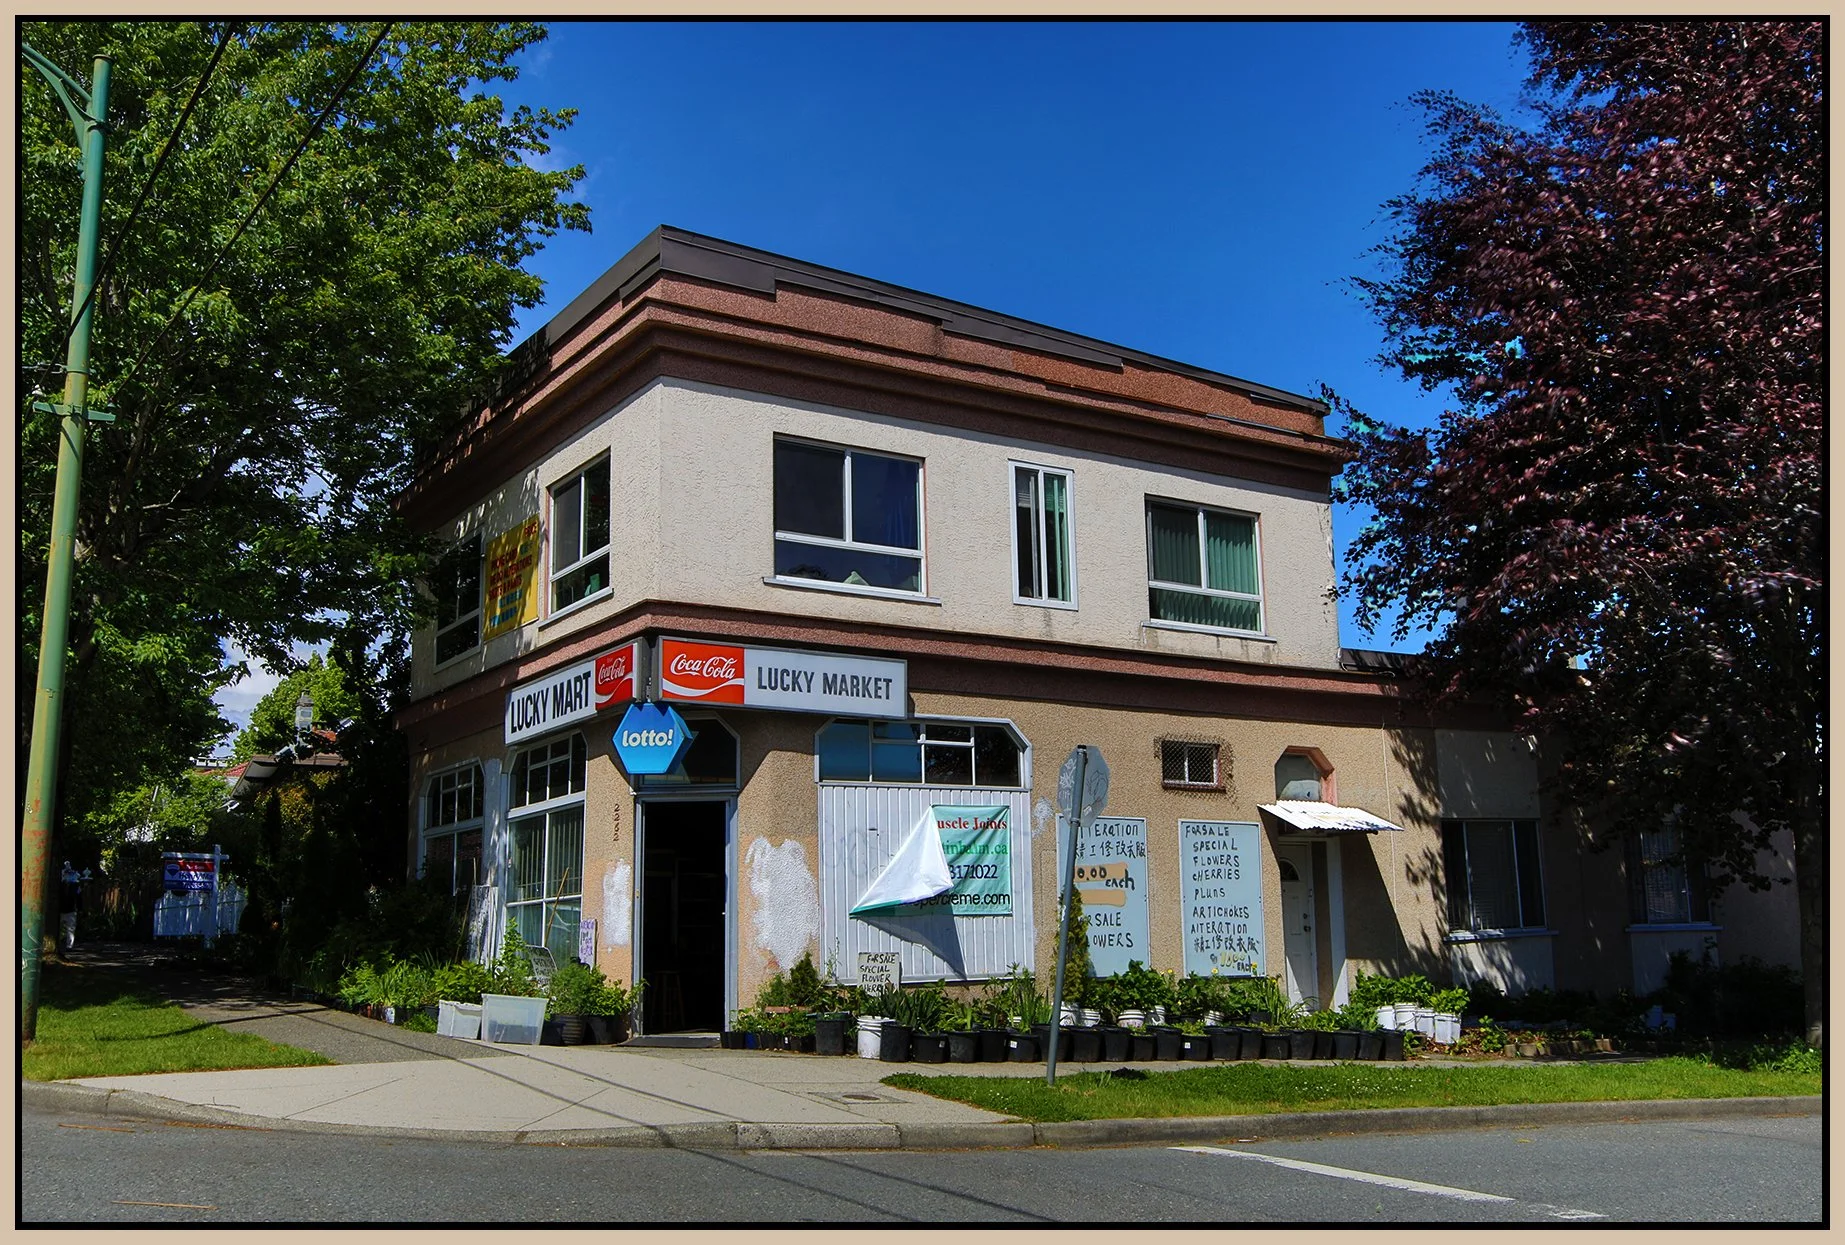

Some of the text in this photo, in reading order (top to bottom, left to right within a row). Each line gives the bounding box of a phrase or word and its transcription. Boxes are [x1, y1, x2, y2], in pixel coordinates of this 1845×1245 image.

[670, 653, 737, 679] Coca-Cola
[757, 666, 893, 700] LUCKY MARKET
[511, 671, 592, 734] LUCKY MART
[622, 729, 674, 747] lotto!
[937, 816, 1008, 831] uscle Joints
[1193, 838, 1238, 853] SPECIAL
[1193, 854, 1240, 868] FLOWERS
[1192, 905, 1250, 919] ARTICHOKES
